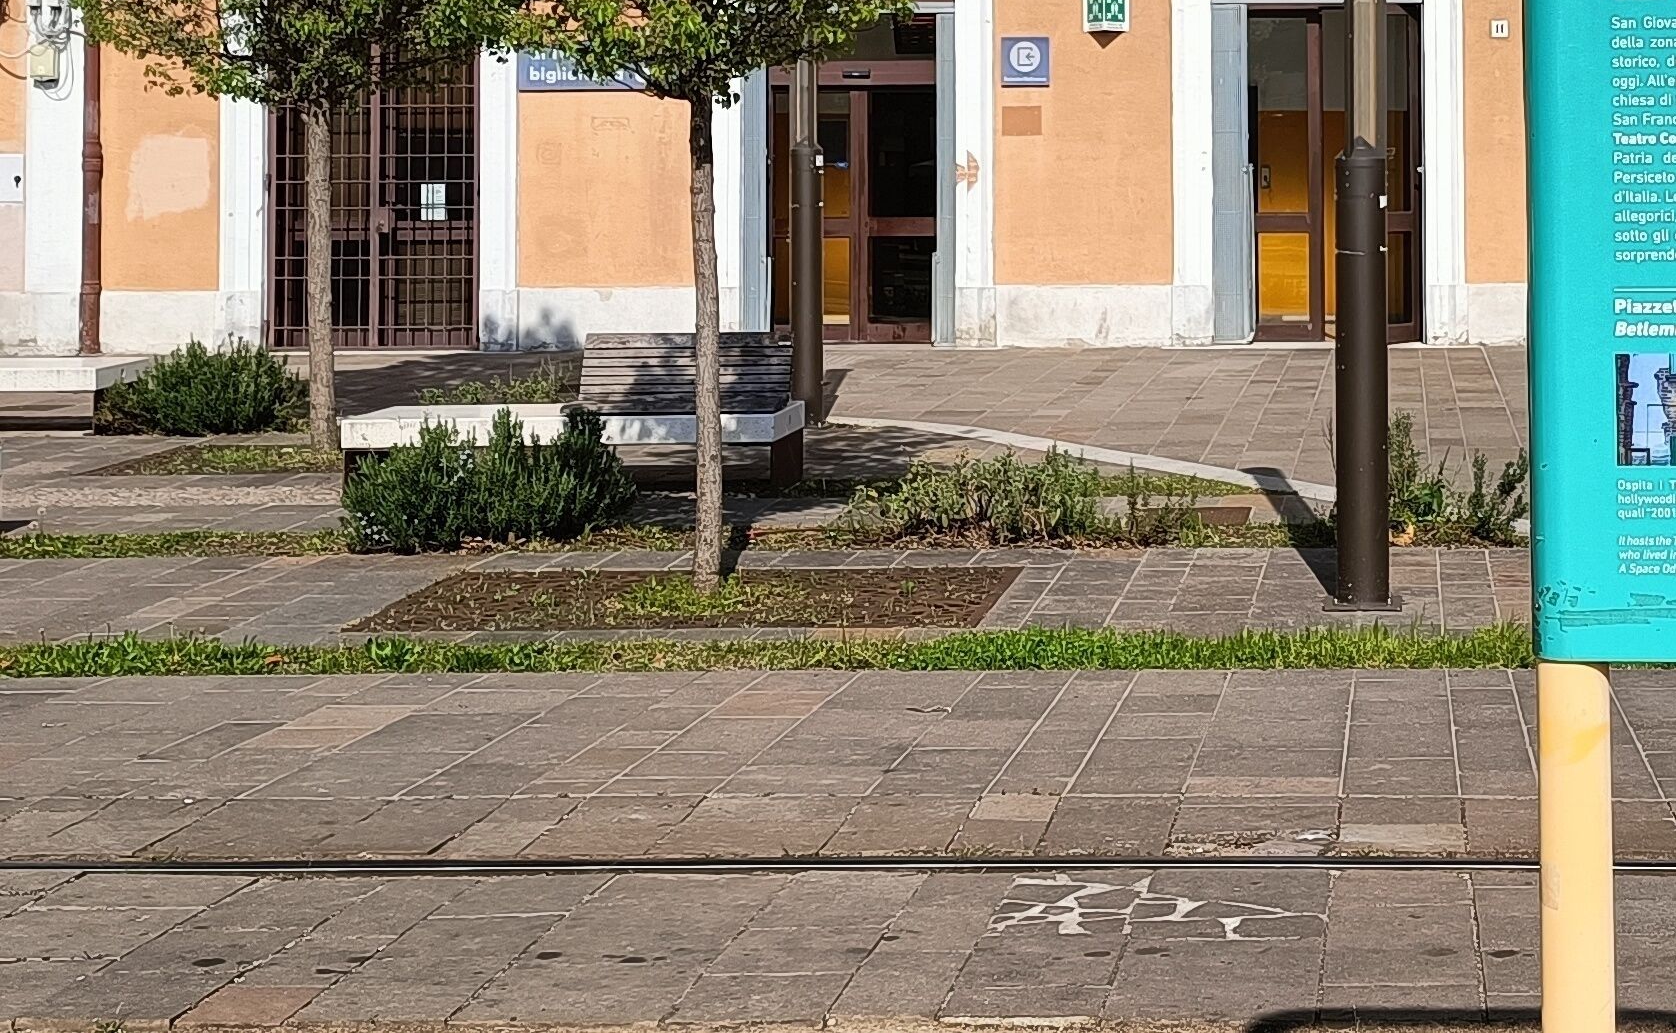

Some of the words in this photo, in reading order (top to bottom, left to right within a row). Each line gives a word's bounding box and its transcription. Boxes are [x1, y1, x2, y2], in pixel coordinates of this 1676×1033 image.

[1612, 36, 1643, 48] della
[1613, 133, 1657, 145] Teatro
[1619, 563, 1626, 573] A
[1629, 563, 1660, 575] Space
